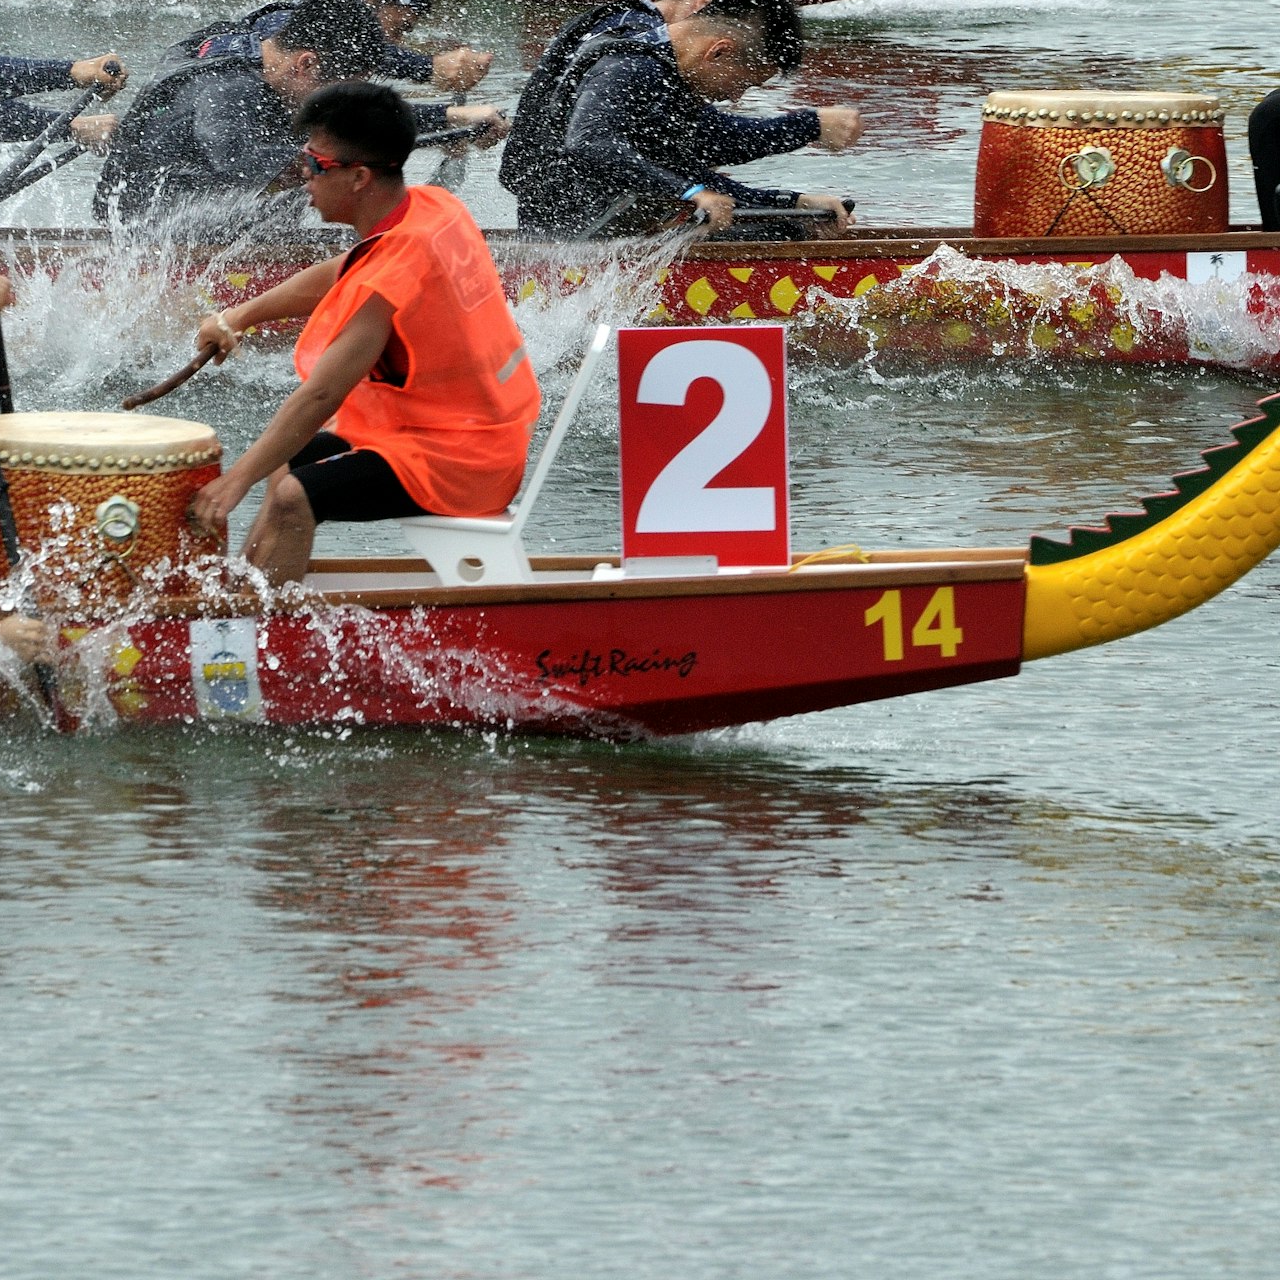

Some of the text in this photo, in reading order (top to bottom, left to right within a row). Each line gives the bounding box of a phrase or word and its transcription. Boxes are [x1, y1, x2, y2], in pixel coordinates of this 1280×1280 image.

[635, 339, 776, 534] 2
[865, 586, 963, 661] 14
[535, 648, 698, 686] Swift Racing
